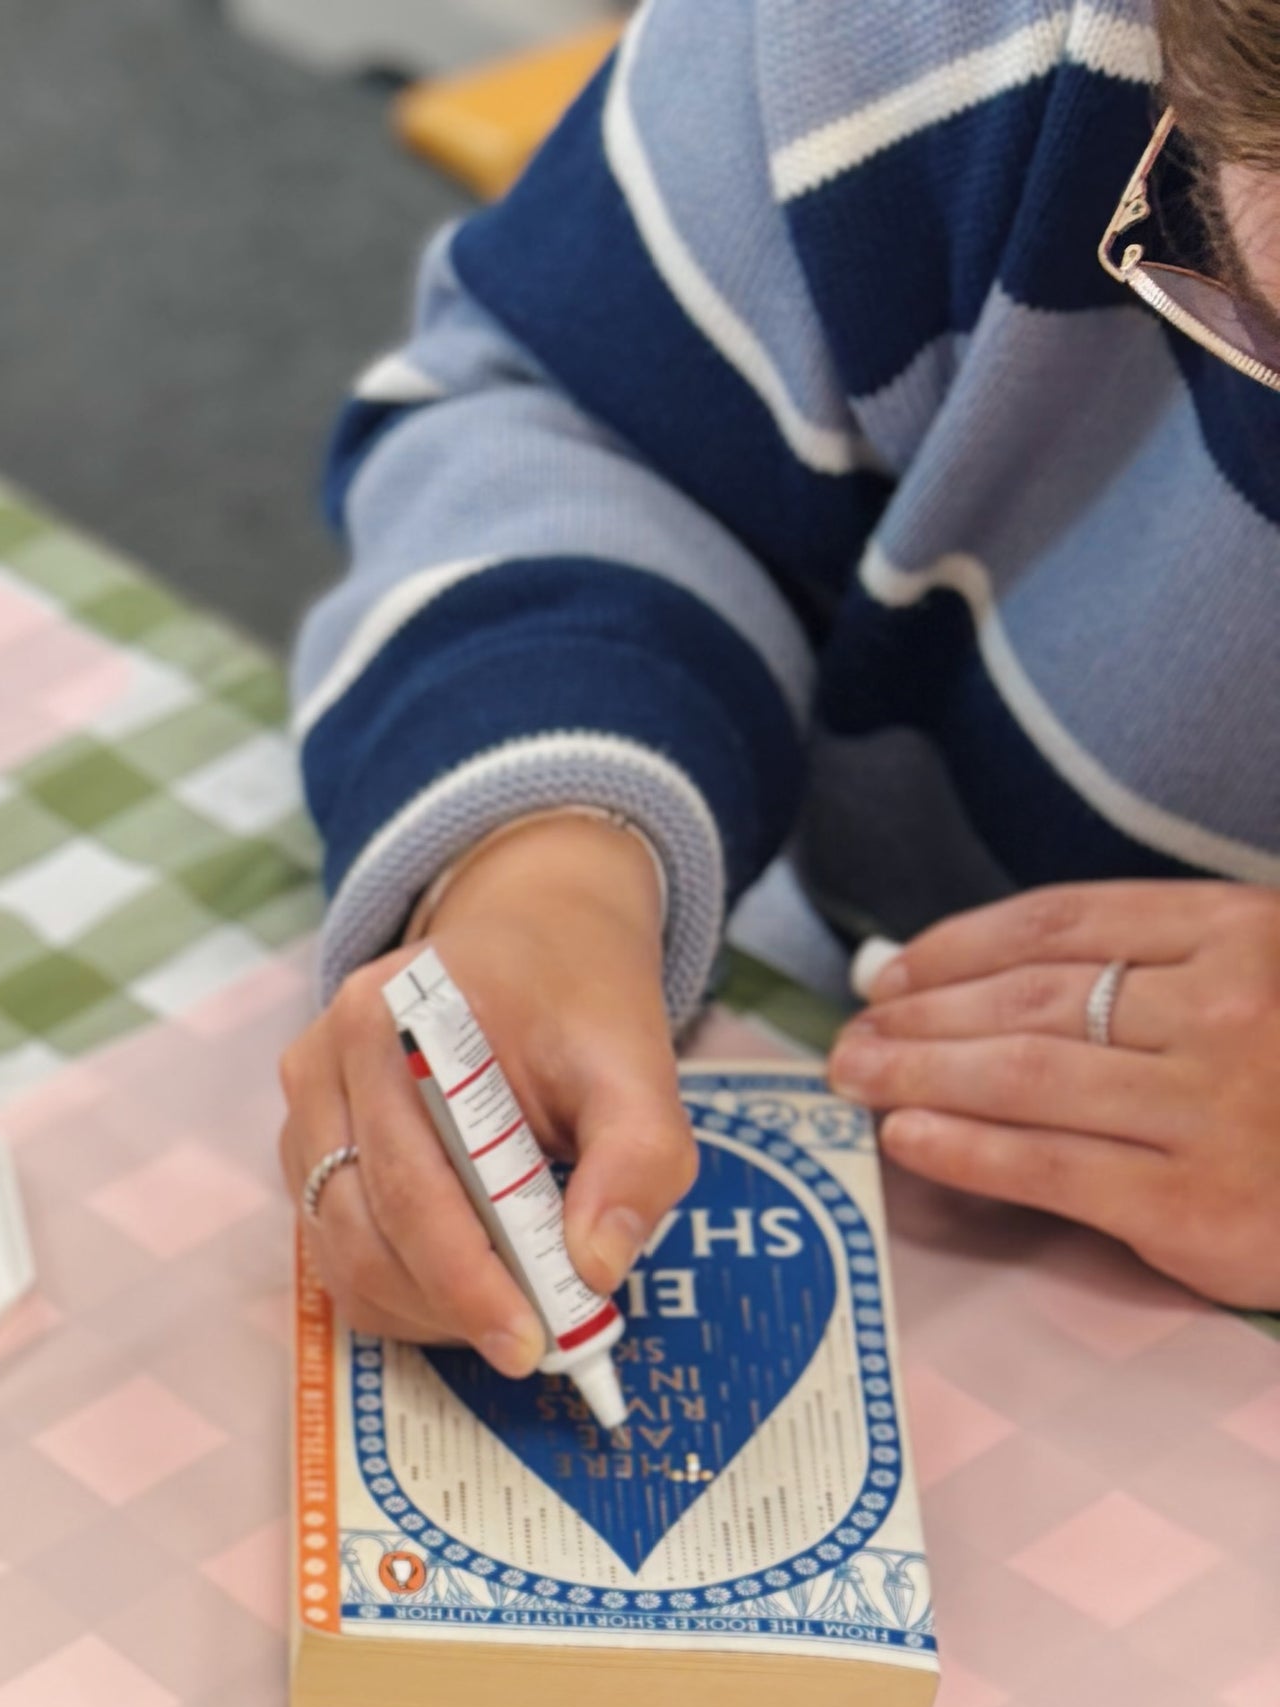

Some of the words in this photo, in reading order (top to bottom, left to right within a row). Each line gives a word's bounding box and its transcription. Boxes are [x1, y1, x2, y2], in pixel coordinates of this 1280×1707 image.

[649, 1366, 700, 1393] IN
[536, 1396, 707, 1422] RIVRS
[392, 1605, 491, 1623] AUTHOR
[501, 1609, 760, 1632] BOOKER-SHORTLISTED
[768, 1619, 816, 1636] THE
[823, 1622, 890, 1643] FROM
